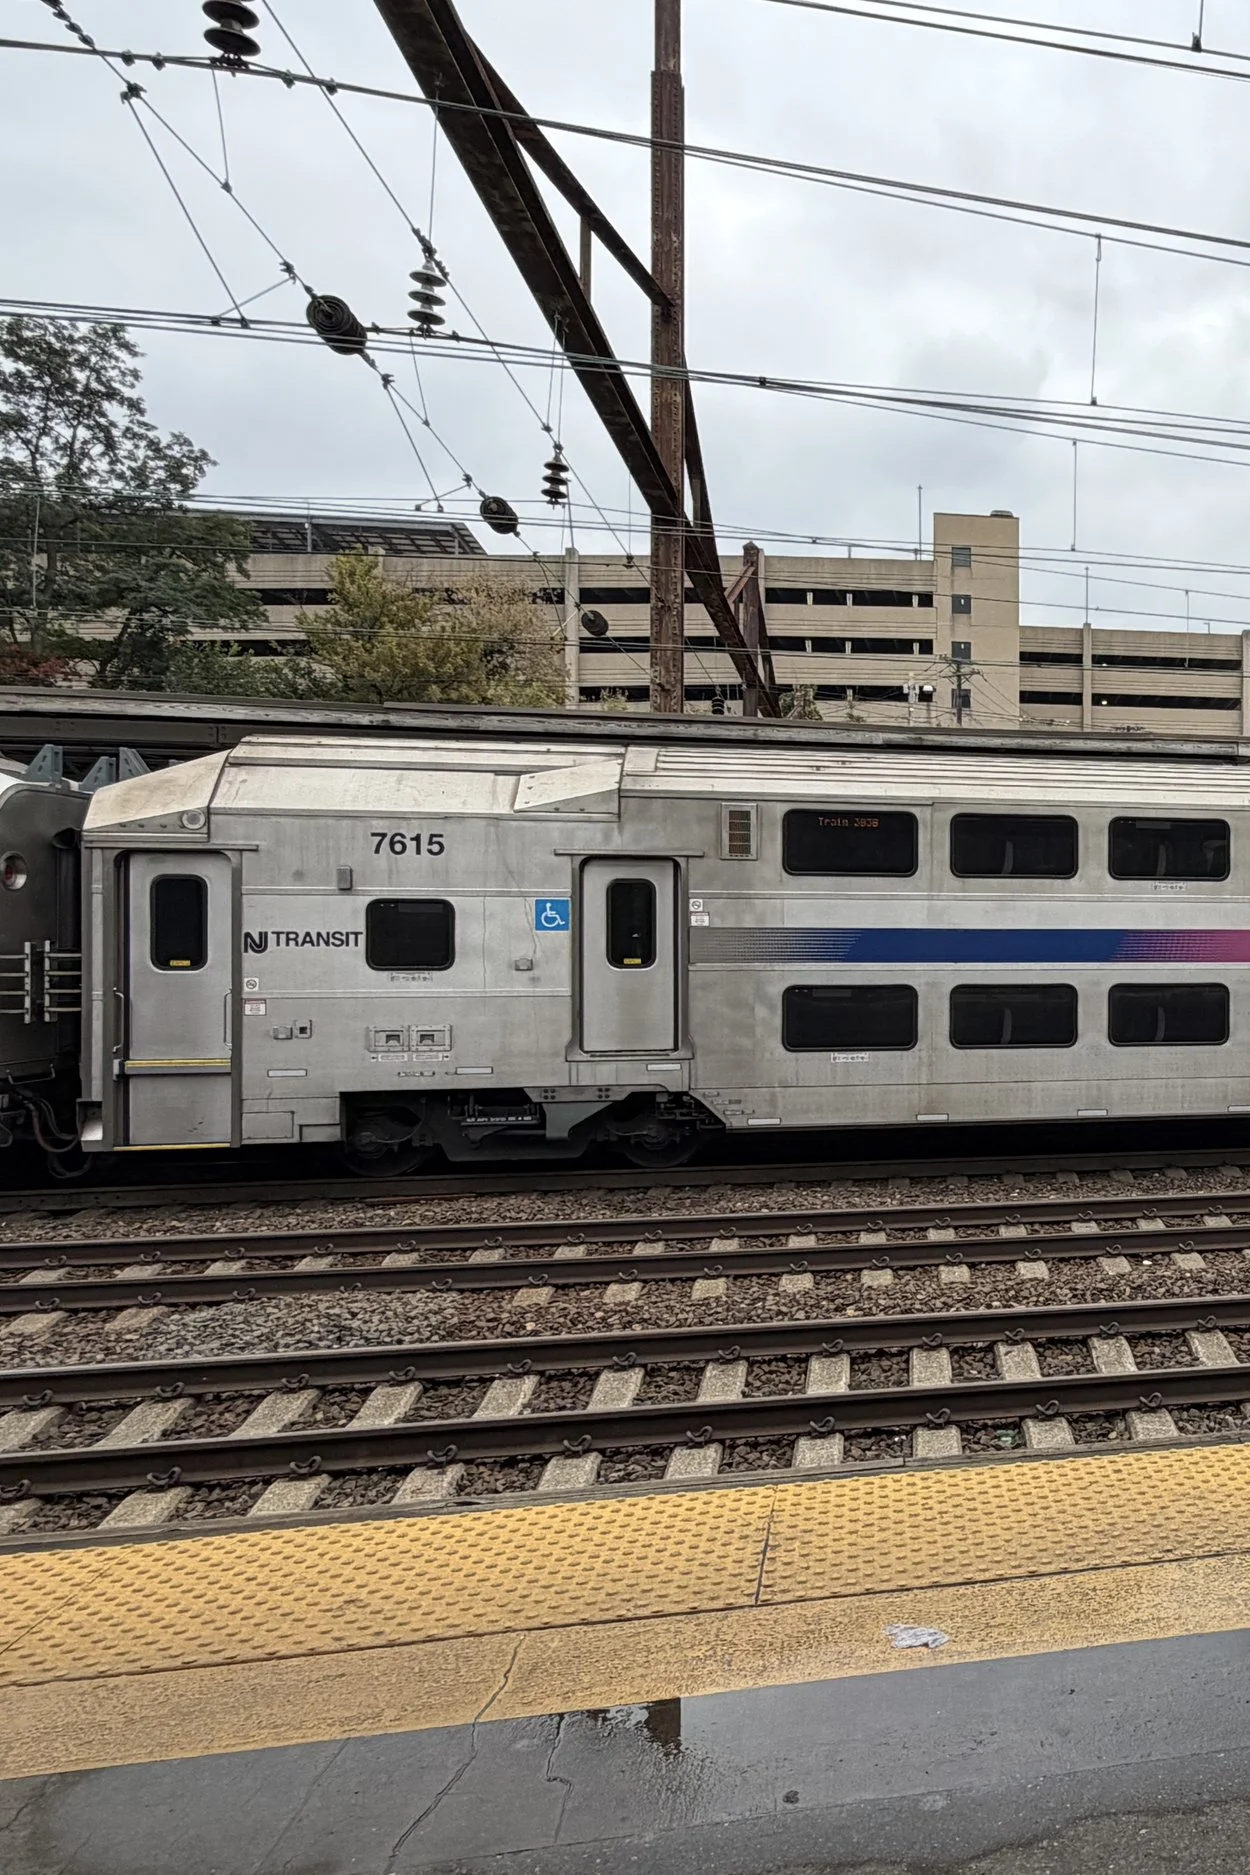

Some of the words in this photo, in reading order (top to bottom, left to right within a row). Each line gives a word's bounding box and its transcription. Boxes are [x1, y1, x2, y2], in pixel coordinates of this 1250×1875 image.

[818, 816, 849, 828] Train
[370, 832, 446, 856] 7615
[271, 931, 364, 948] TRANSIT
